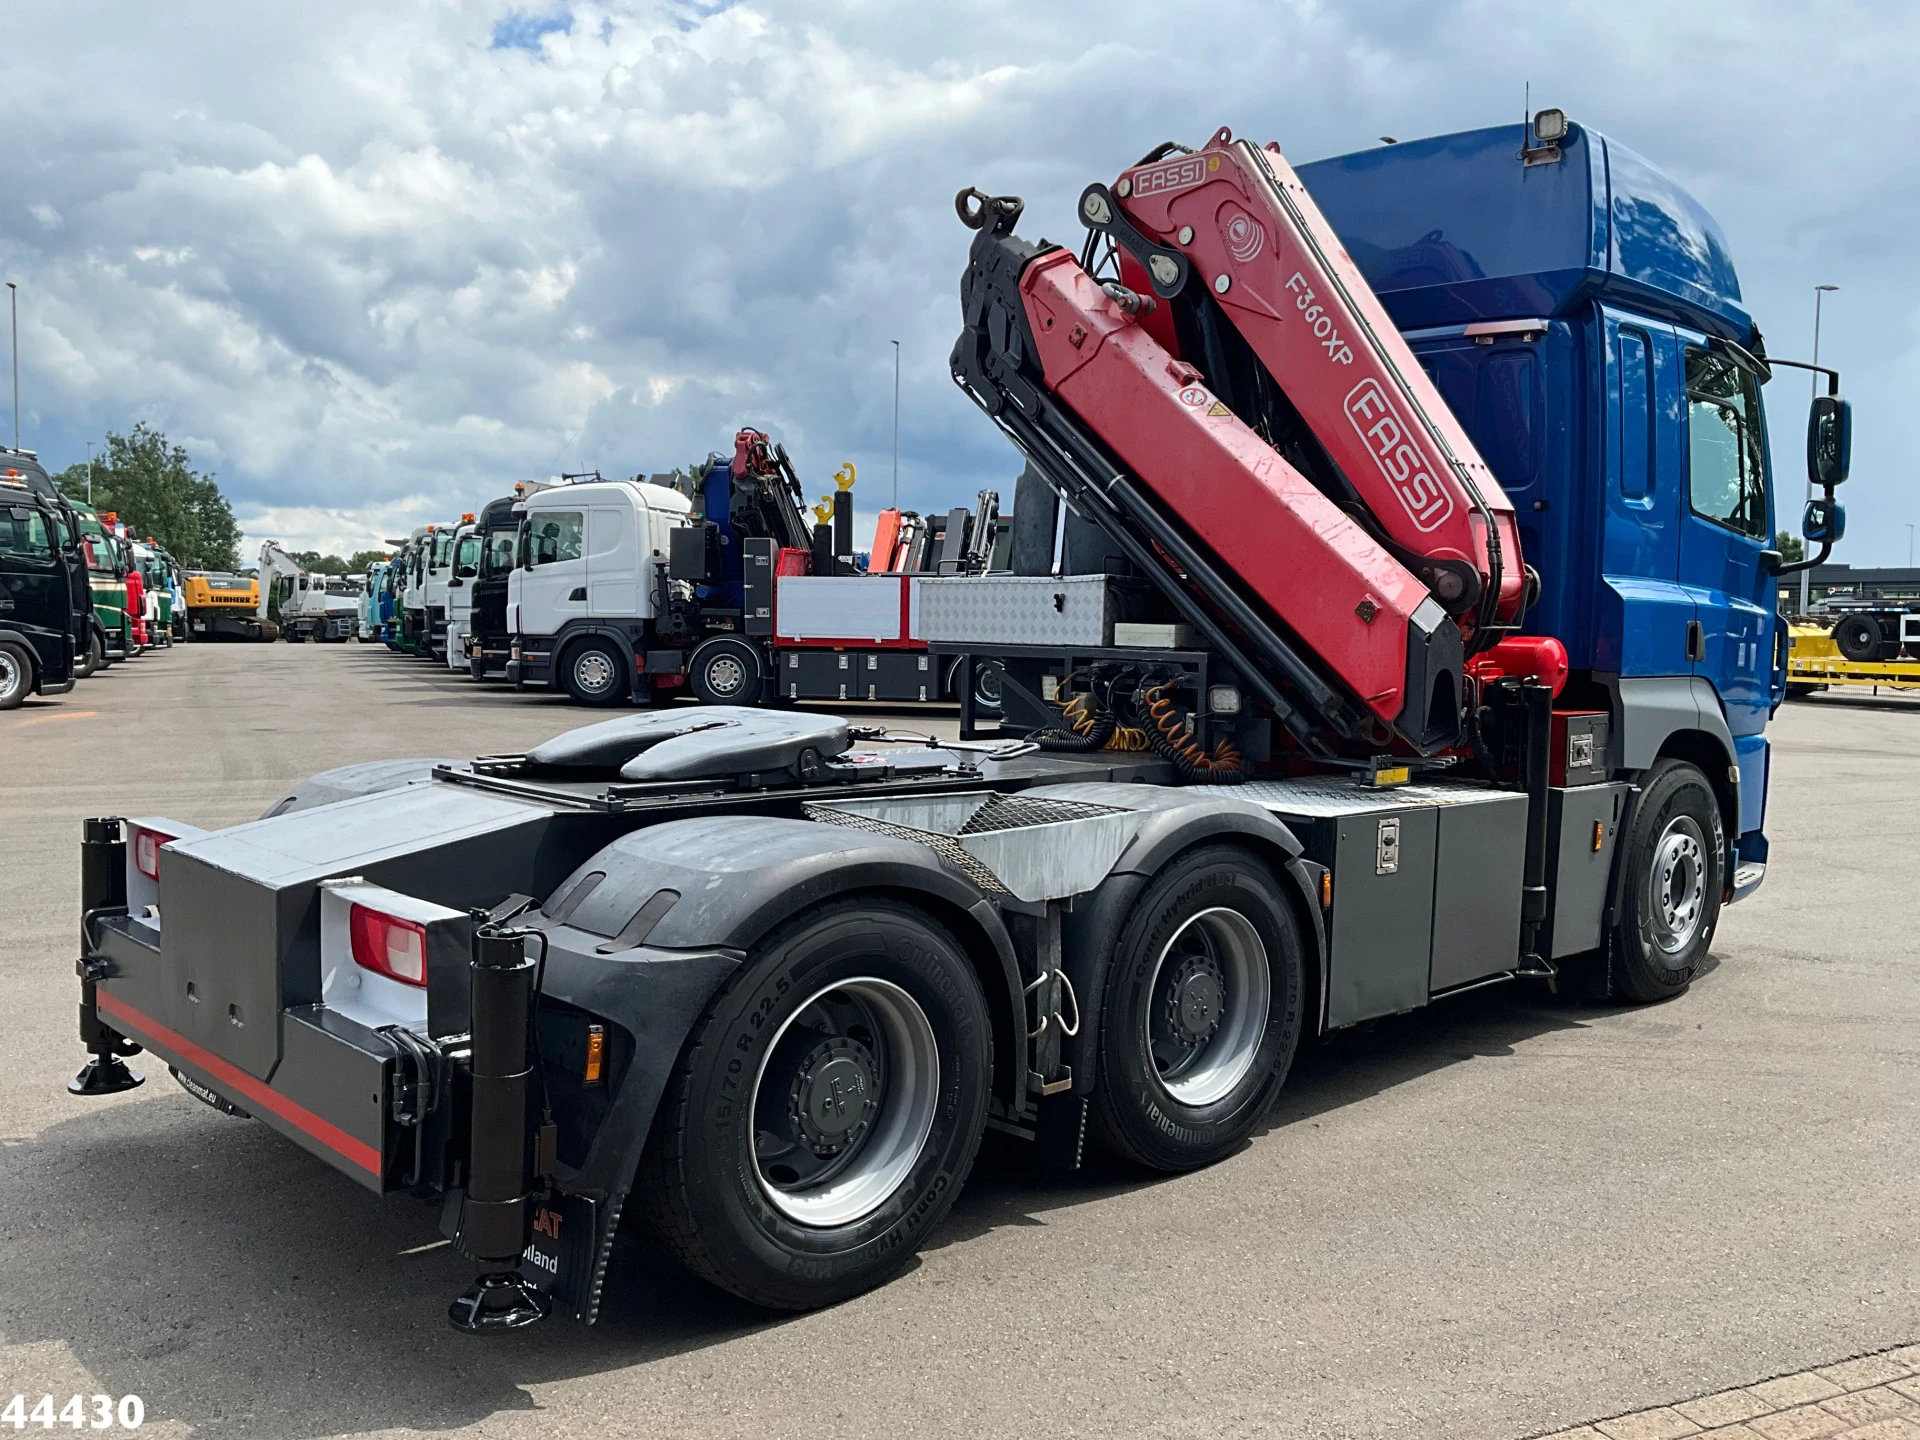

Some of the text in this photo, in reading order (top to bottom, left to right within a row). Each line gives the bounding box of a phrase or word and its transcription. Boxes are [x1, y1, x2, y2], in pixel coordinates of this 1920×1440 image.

[1138, 163, 1200, 192] FASSI
[1284, 271, 1355, 365] F360XP
[1352, 389, 1444, 521] FASSI
[1161, 878, 1203, 924] Hybrid
[750, 976, 790, 1031] 22.5
[1145, 1100, 1216, 1146] Continental
[905, 1175, 948, 1232] Conti
